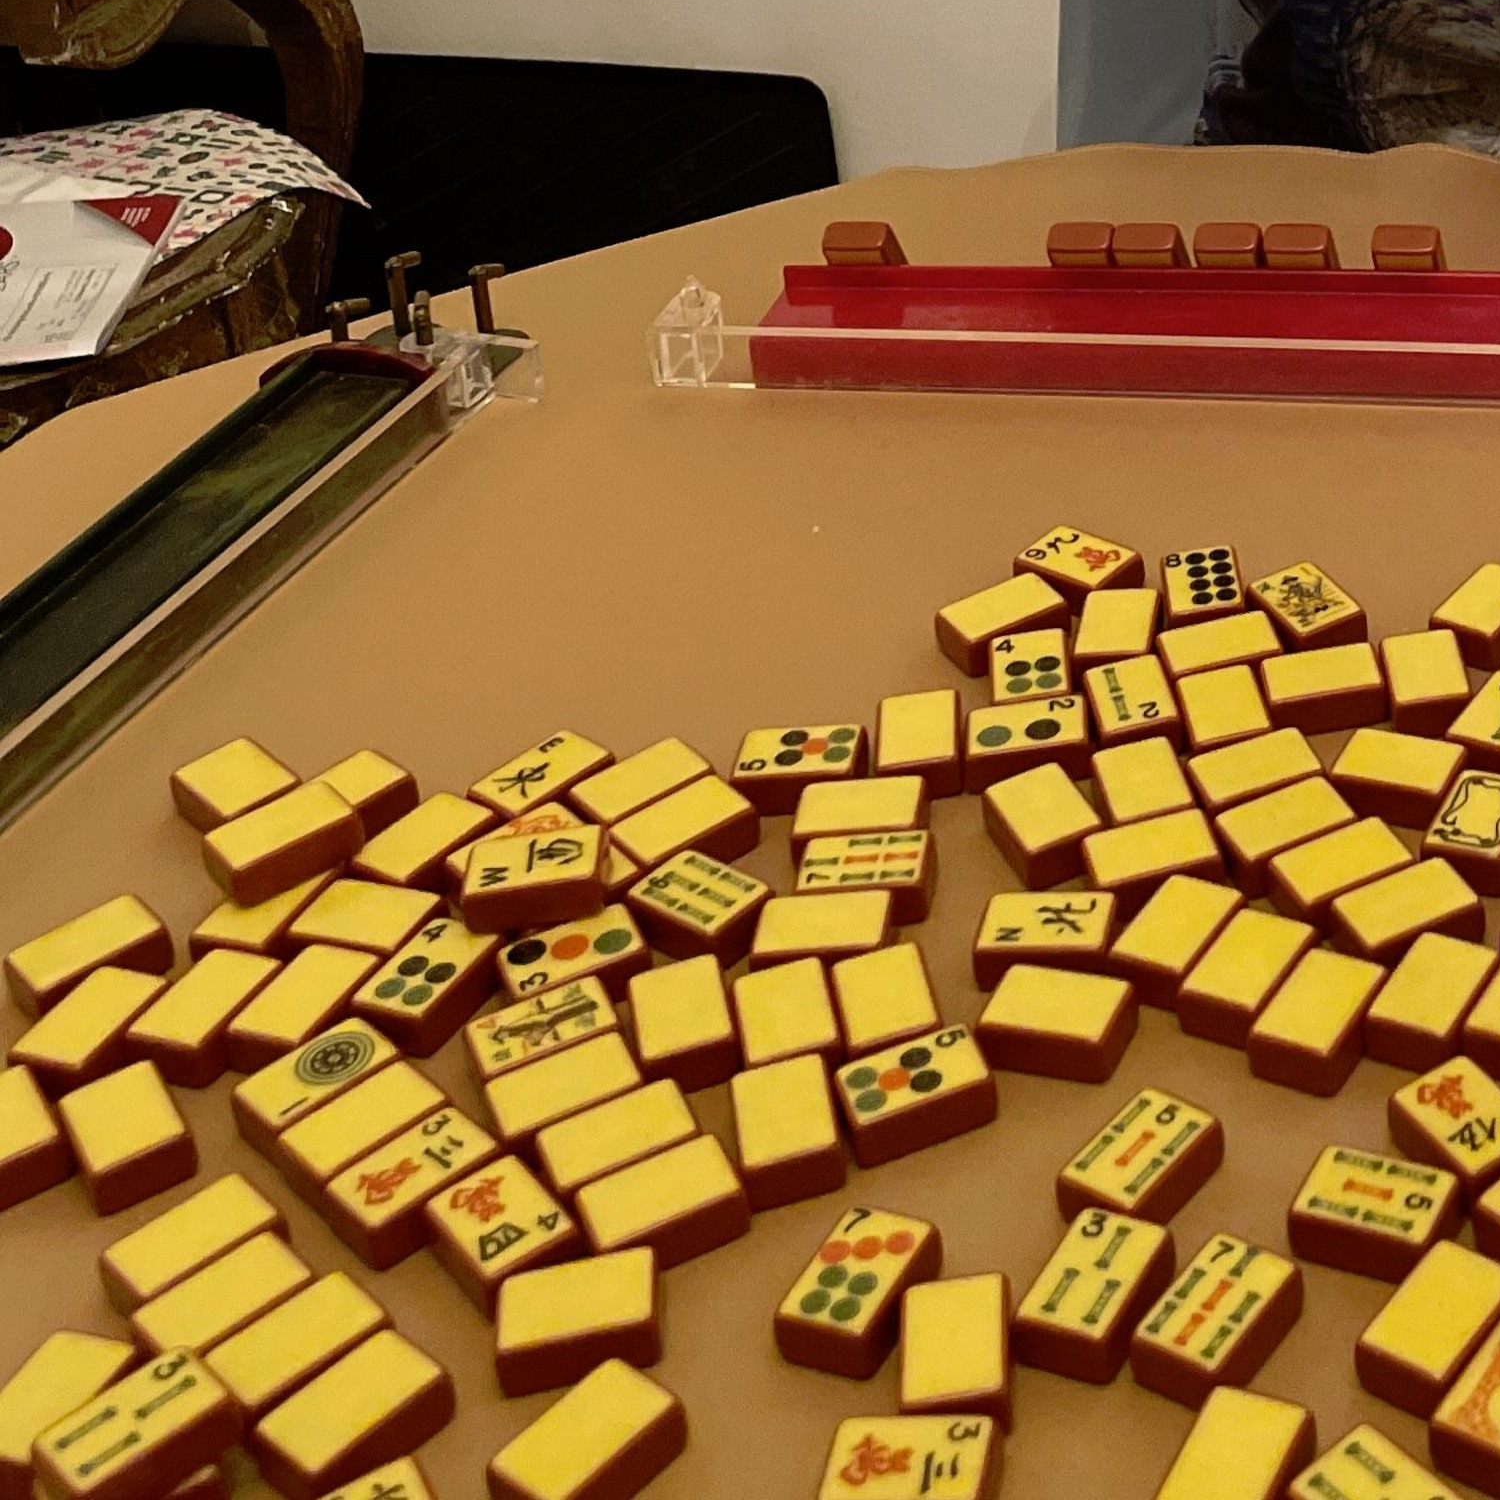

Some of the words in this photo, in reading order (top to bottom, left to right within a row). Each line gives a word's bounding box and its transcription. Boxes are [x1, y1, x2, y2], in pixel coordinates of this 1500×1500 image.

[1165, 554, 1181, 568] 8
[994, 639, 1014, 655] 4
[843, 1207, 872, 1233] 7
[1209, 1241, 1236, 1263] 7
